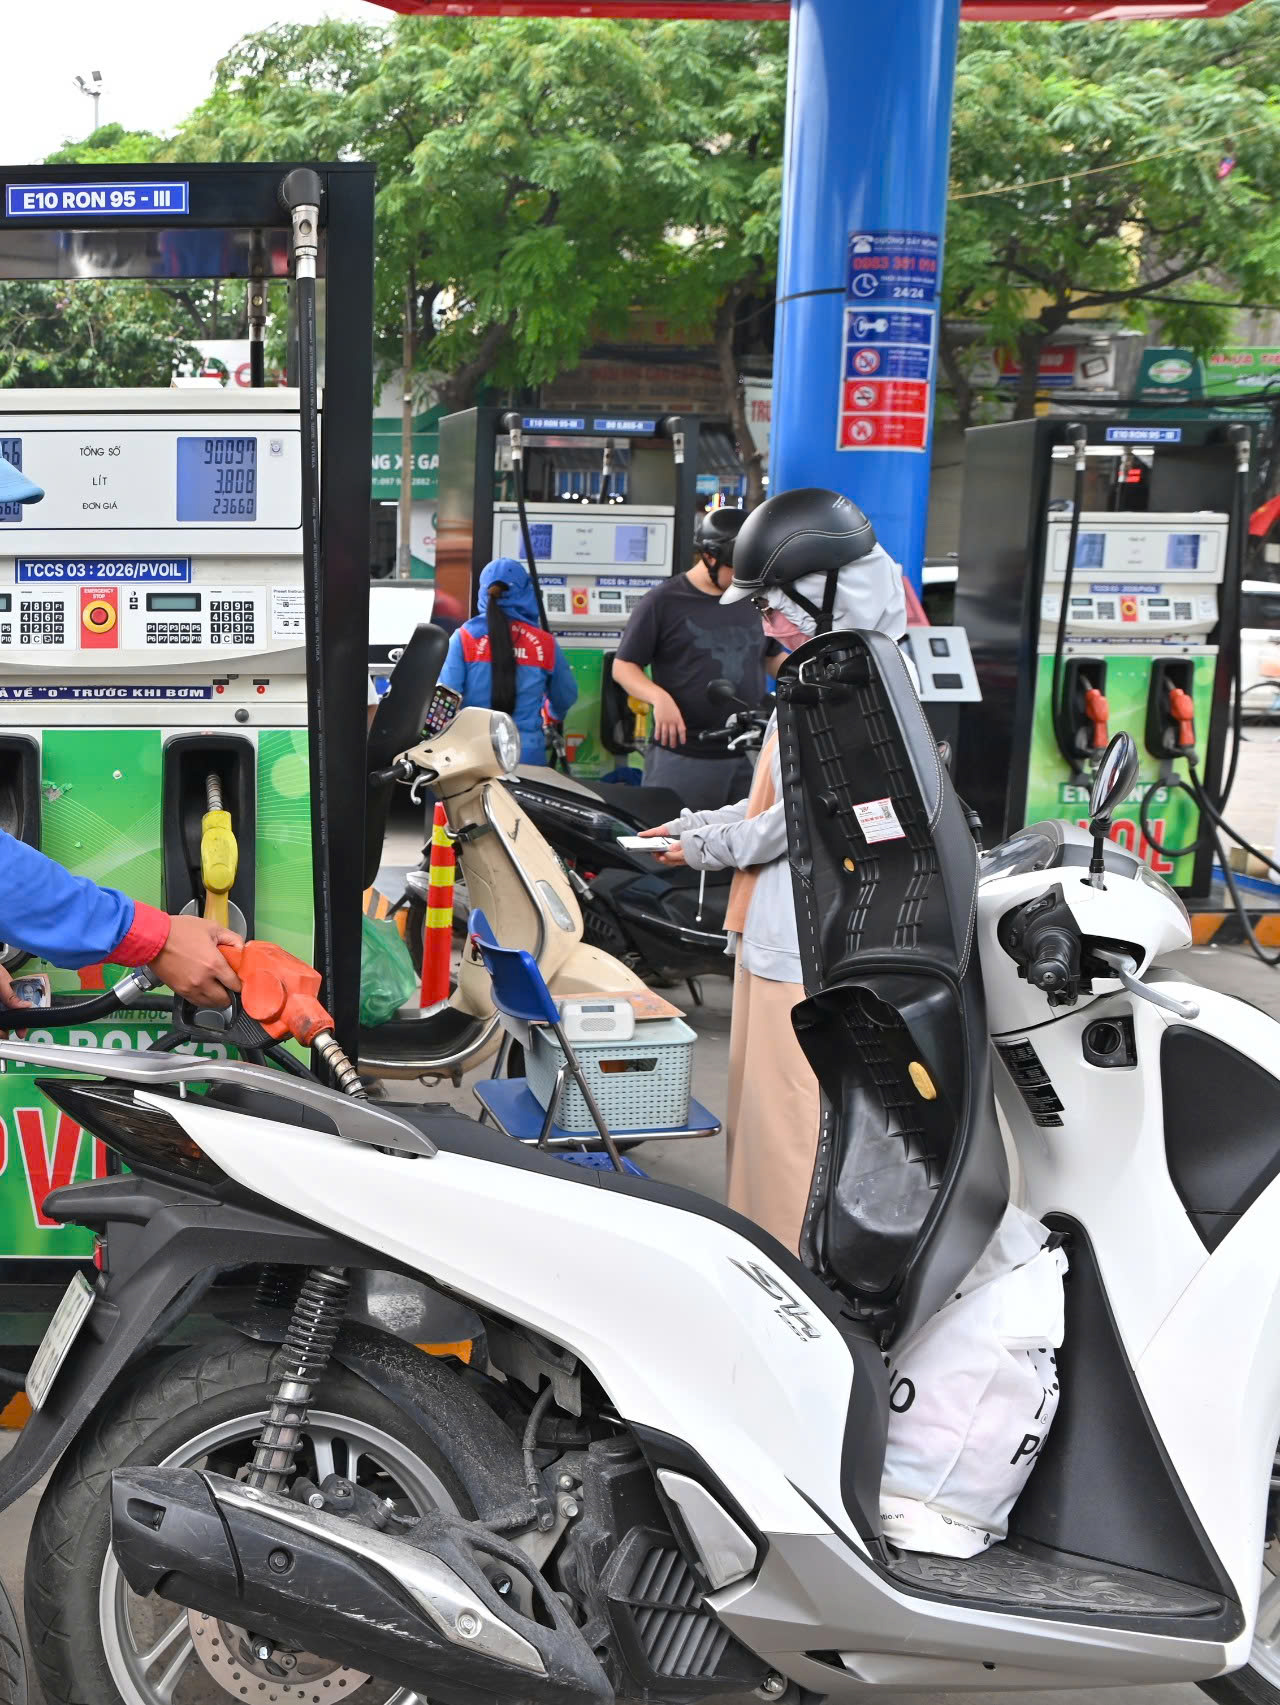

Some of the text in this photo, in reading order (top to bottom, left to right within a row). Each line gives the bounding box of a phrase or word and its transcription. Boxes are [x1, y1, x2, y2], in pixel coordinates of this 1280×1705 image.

[23, 192, 58, 210] E10
[62, 191, 106, 209] RON
[110, 190, 136, 208] 95
[79, 444, 121, 458] TỔNG SỐ
[203, 439, 256, 465] 90097
[92, 475, 108, 486] LÍT
[82, 500, 118, 510] ĐƠN GIÁ
[213, 497, 255, 515] 23660
[25, 564, 64, 577] TCCS
[66, 564, 86, 577] 03
[97, 563, 182, 578] 2026/PVOIL
[13, 686, 34, 698] VỀ
[72, 687, 128, 697] TRƯỚC
[132, 689, 161, 697] KHI
[166, 688, 204, 698] BƠM
[137, 1010, 168, 1023] HỌC
